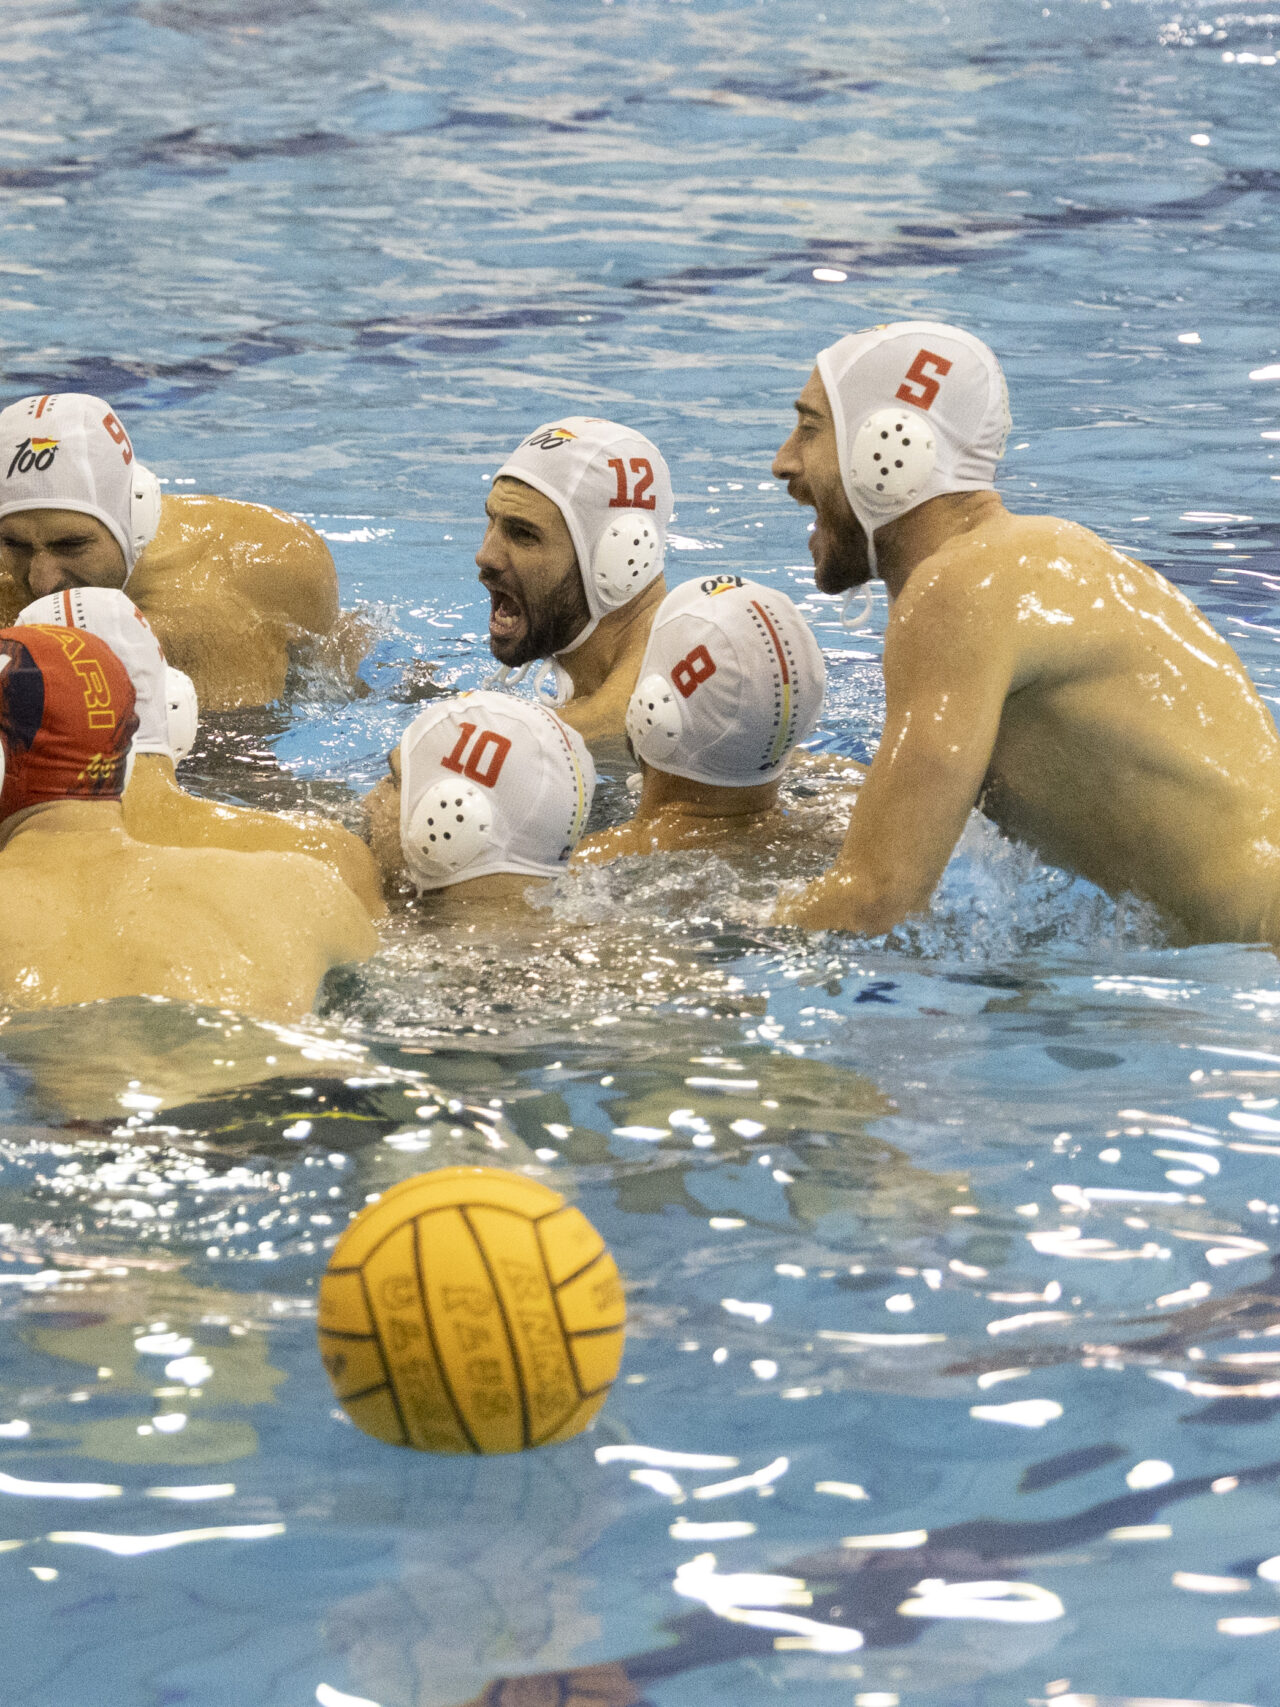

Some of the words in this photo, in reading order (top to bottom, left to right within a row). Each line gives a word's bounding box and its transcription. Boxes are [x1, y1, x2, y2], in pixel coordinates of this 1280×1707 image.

[895, 348, 953, 411] 5
[6, 437, 58, 479] 100
[102, 412, 133, 466] 9
[607, 457, 657, 511] 12
[670, 644, 717, 699] 8
[440, 721, 513, 789] 10
